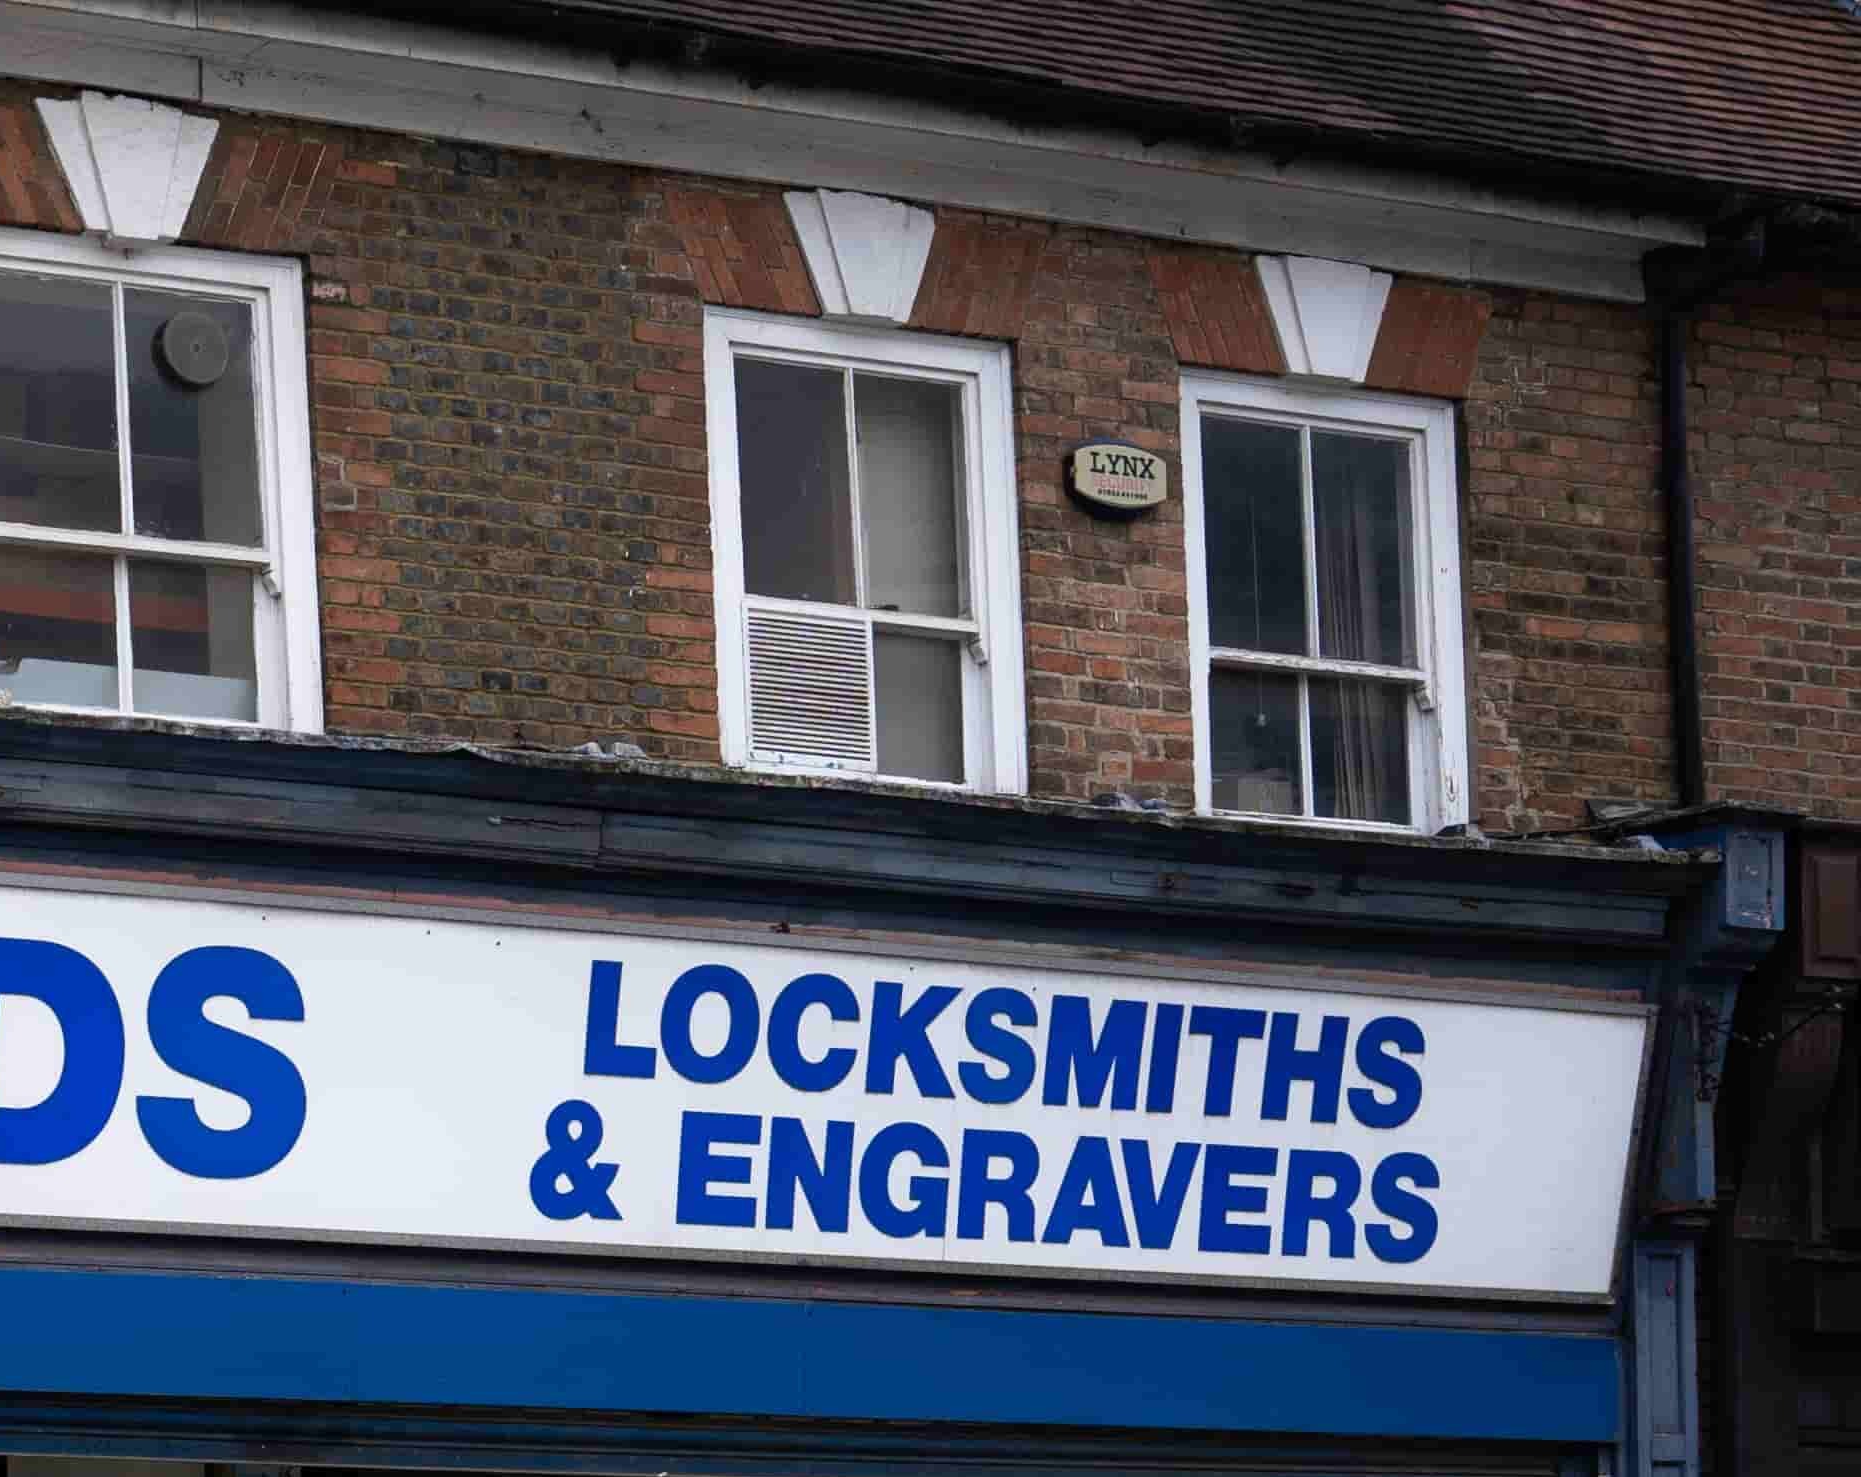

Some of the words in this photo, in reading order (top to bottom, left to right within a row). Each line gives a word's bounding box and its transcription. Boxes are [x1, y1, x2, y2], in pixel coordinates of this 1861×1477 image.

[1090, 452, 1156, 480] LYNX
[582, 959, 1426, 1130] LOCKSMITHS
[529, 1099, 622, 1221] &
[675, 1111, 1440, 1264] ENGRAVERS
